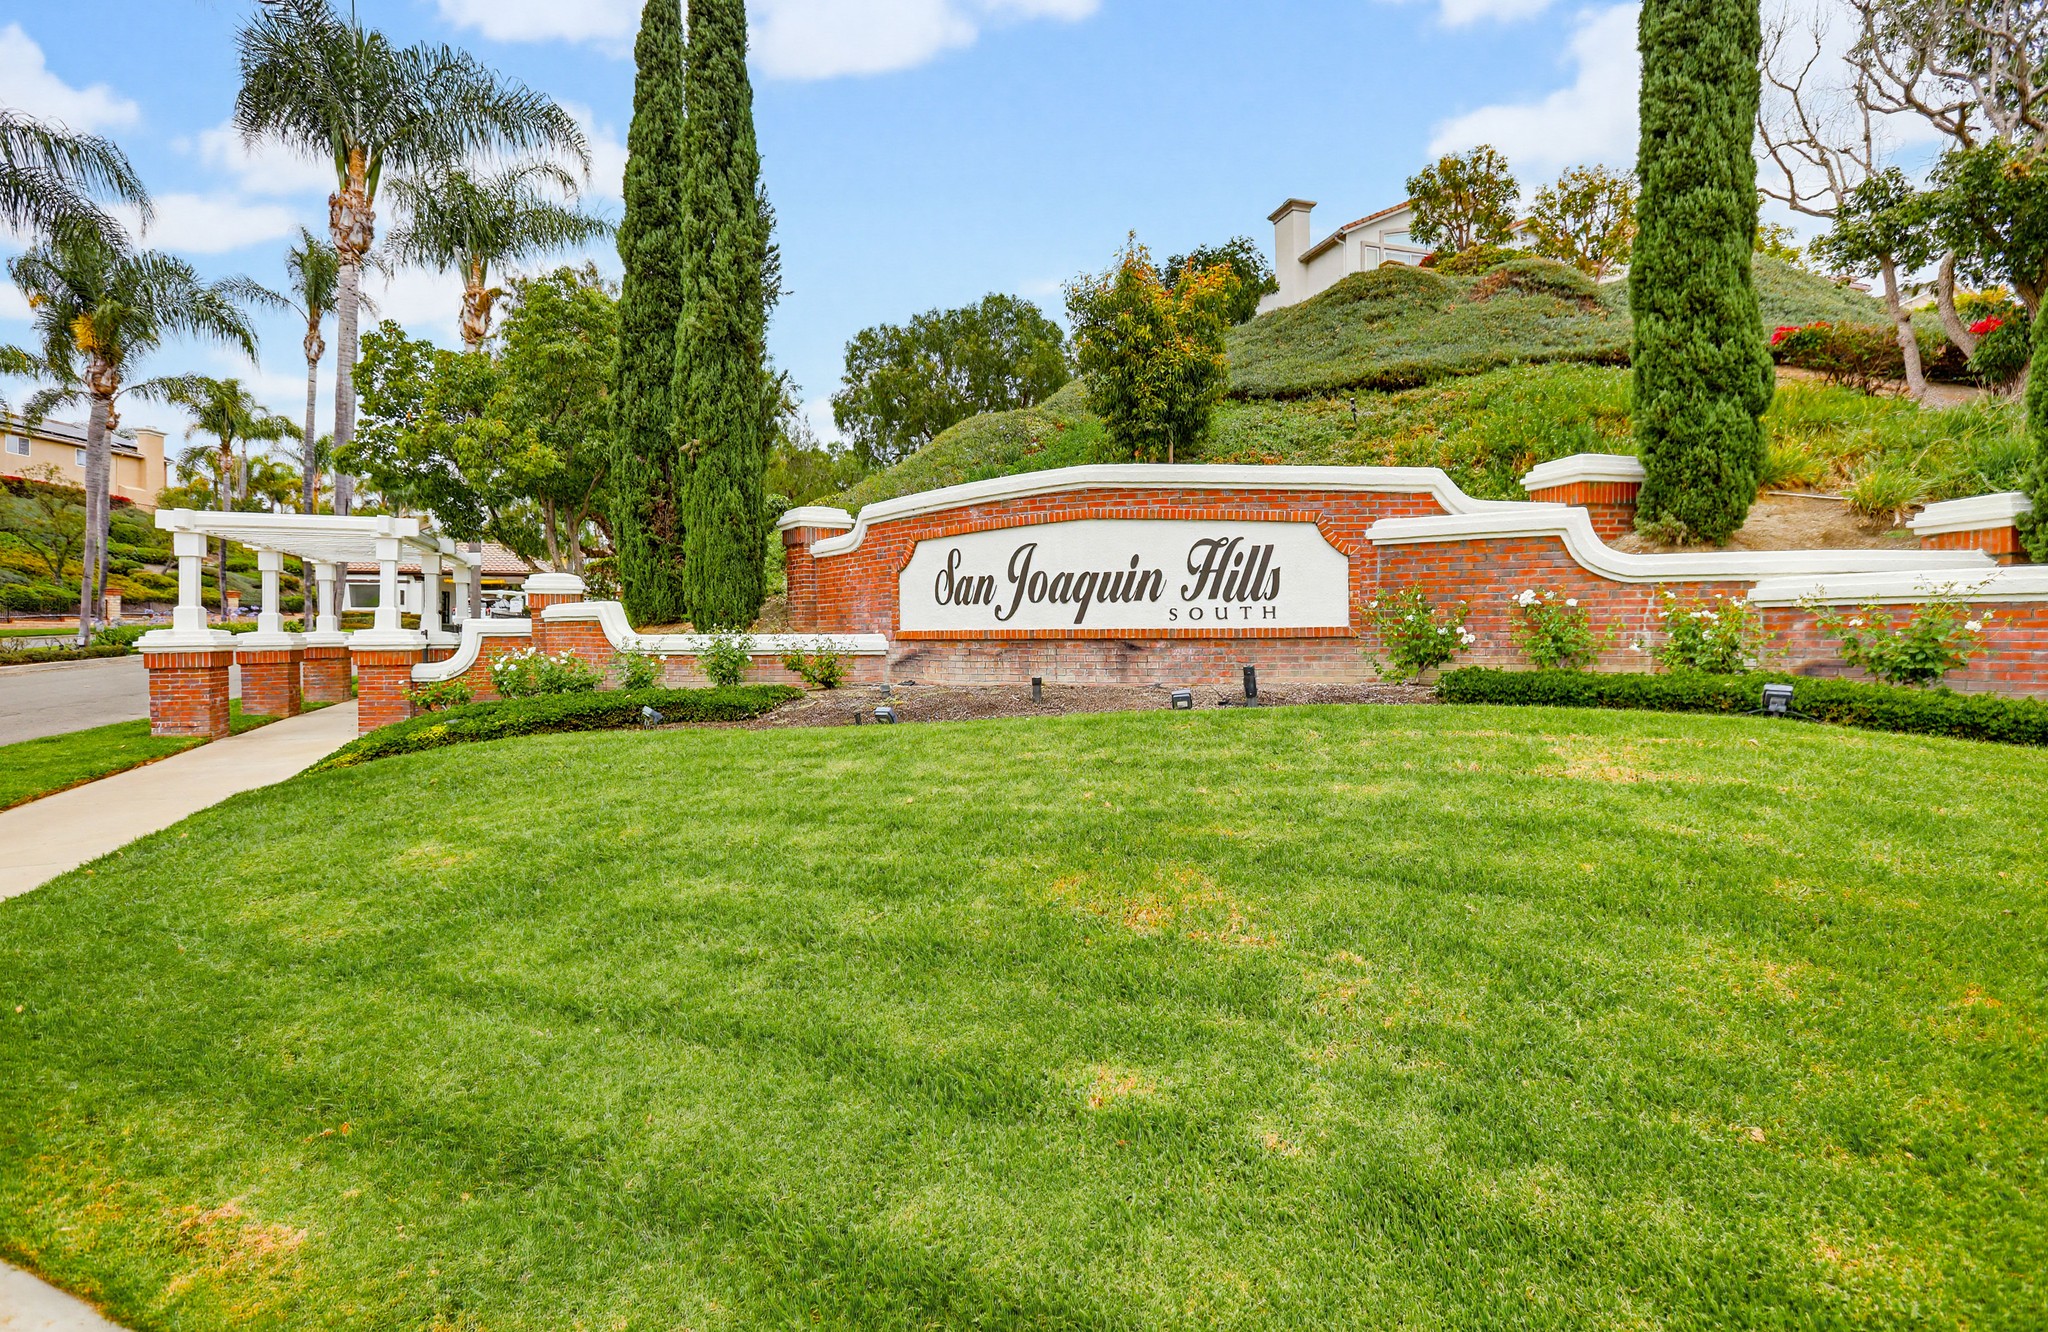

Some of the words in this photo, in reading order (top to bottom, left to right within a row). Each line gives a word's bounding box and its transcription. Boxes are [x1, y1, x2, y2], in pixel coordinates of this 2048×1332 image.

[935, 548, 997, 606] San
[995, 542, 1167, 625] Joaquin
[1180, 536, 1281, 603] Hills
[1168, 606, 1277, 621] SOUTH
